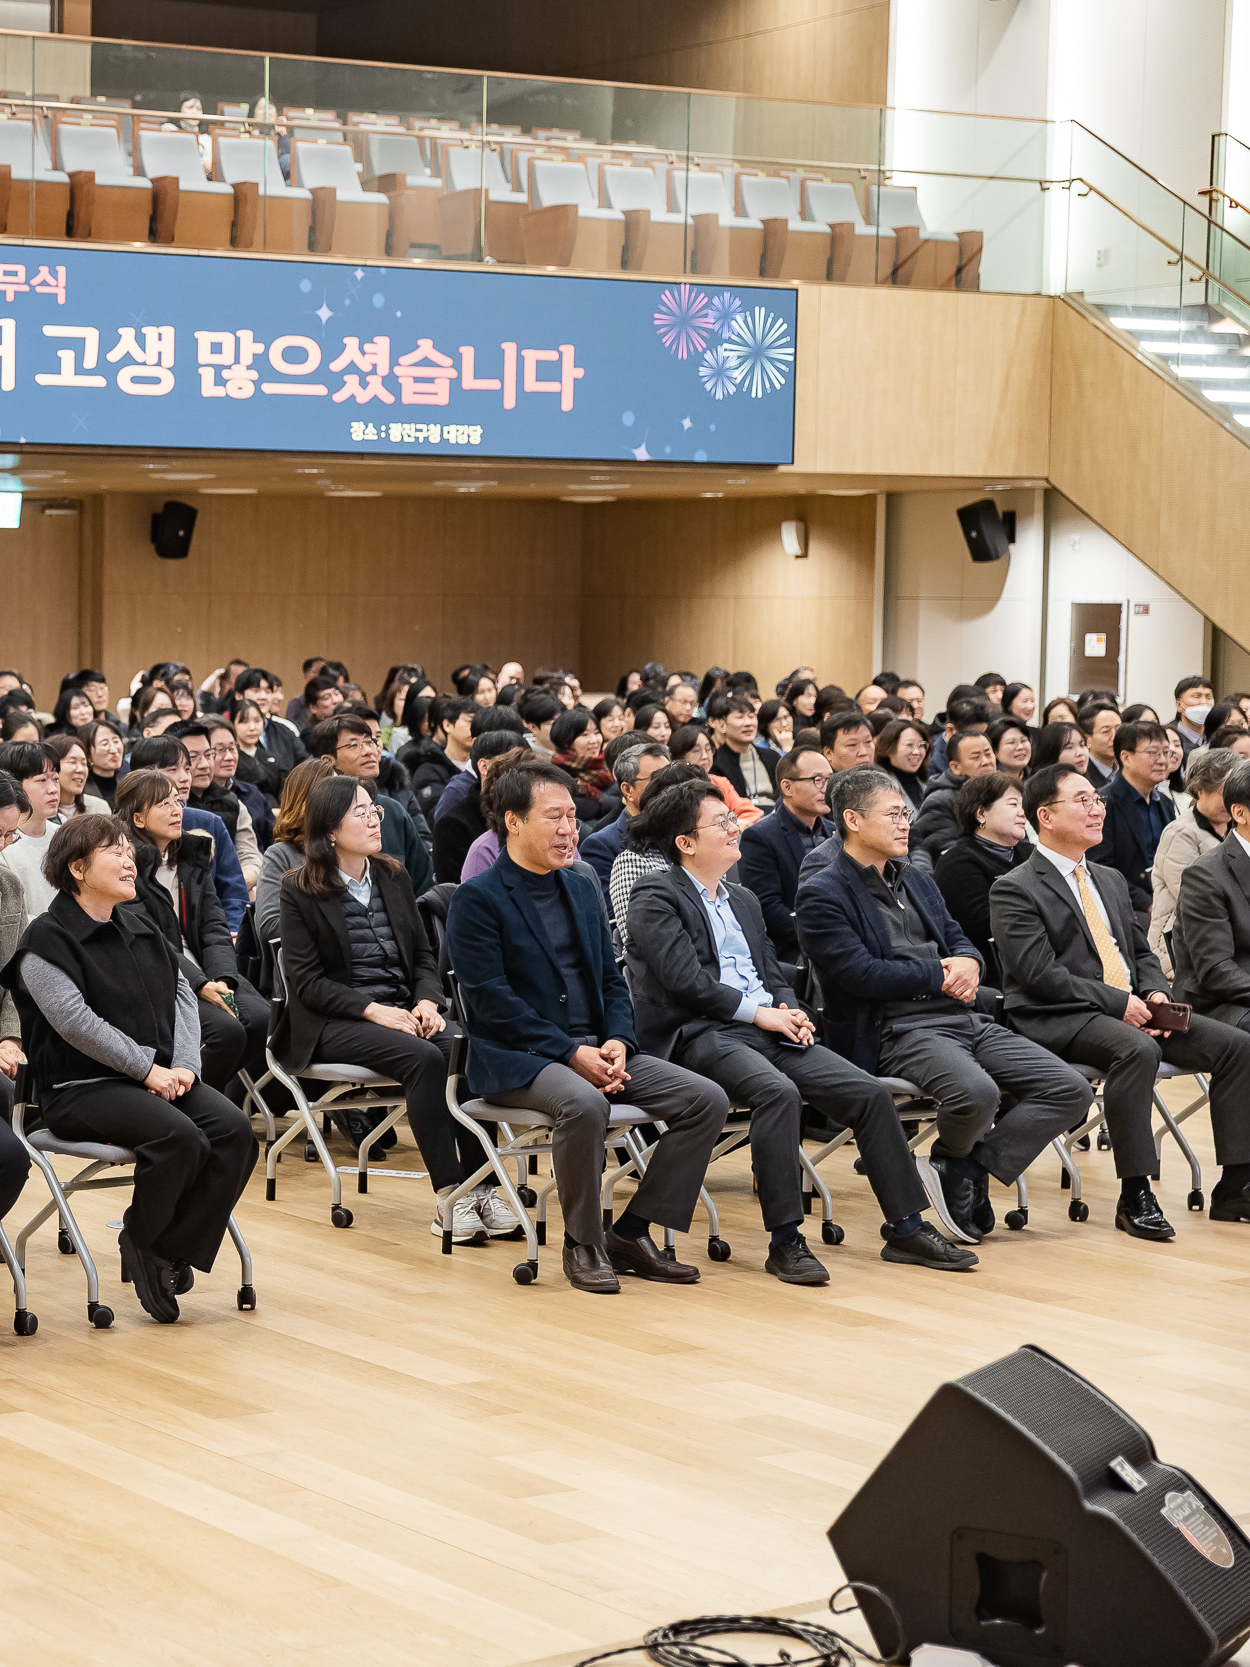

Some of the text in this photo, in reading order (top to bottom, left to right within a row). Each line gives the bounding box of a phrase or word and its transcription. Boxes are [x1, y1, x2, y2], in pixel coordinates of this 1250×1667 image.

[34, 324, 176, 397] 고생
[193, 329, 585, 412] 많으셨습니다
[350, 421, 379, 442] 장소
[388, 422, 441, 444] 광진구청
[442, 424, 484, 445] 대강당
